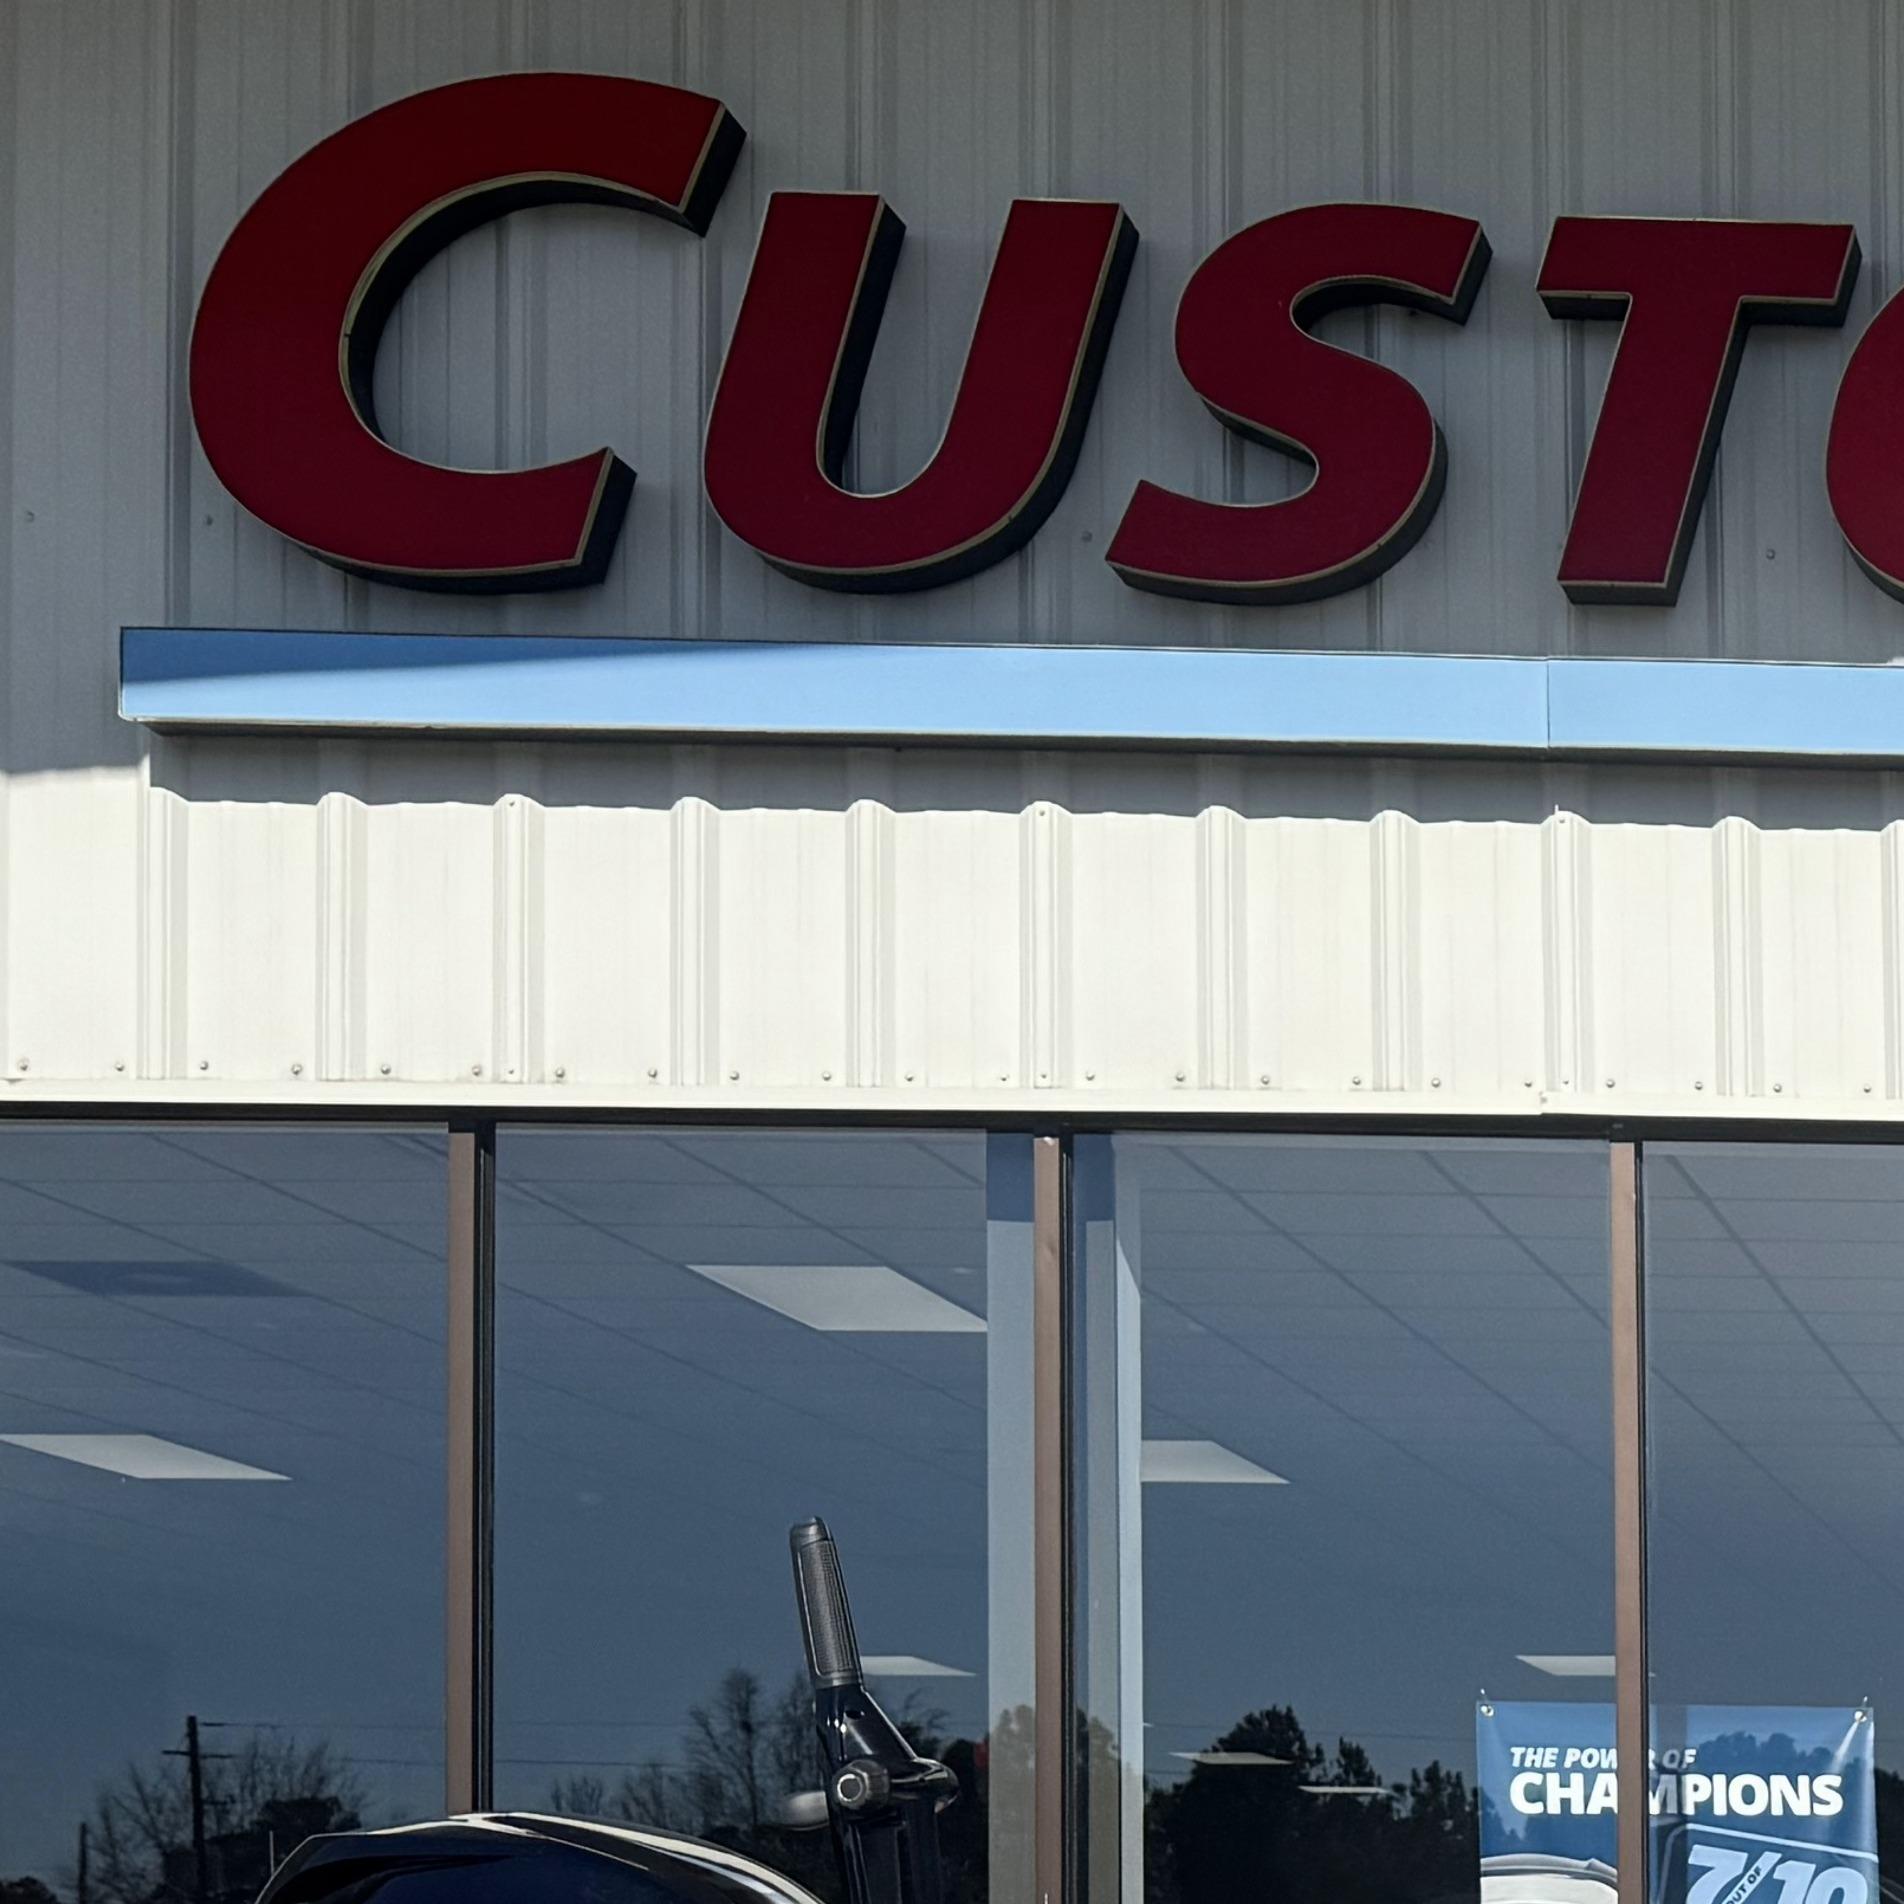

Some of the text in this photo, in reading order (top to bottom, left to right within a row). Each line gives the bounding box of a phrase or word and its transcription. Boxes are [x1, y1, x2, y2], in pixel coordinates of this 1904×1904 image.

[1510, 1747, 1696, 1770] THE POW OF
[1509, 1772, 1843, 1816] CHAMPIONS
[1747, 1866, 1762, 1885] OF
